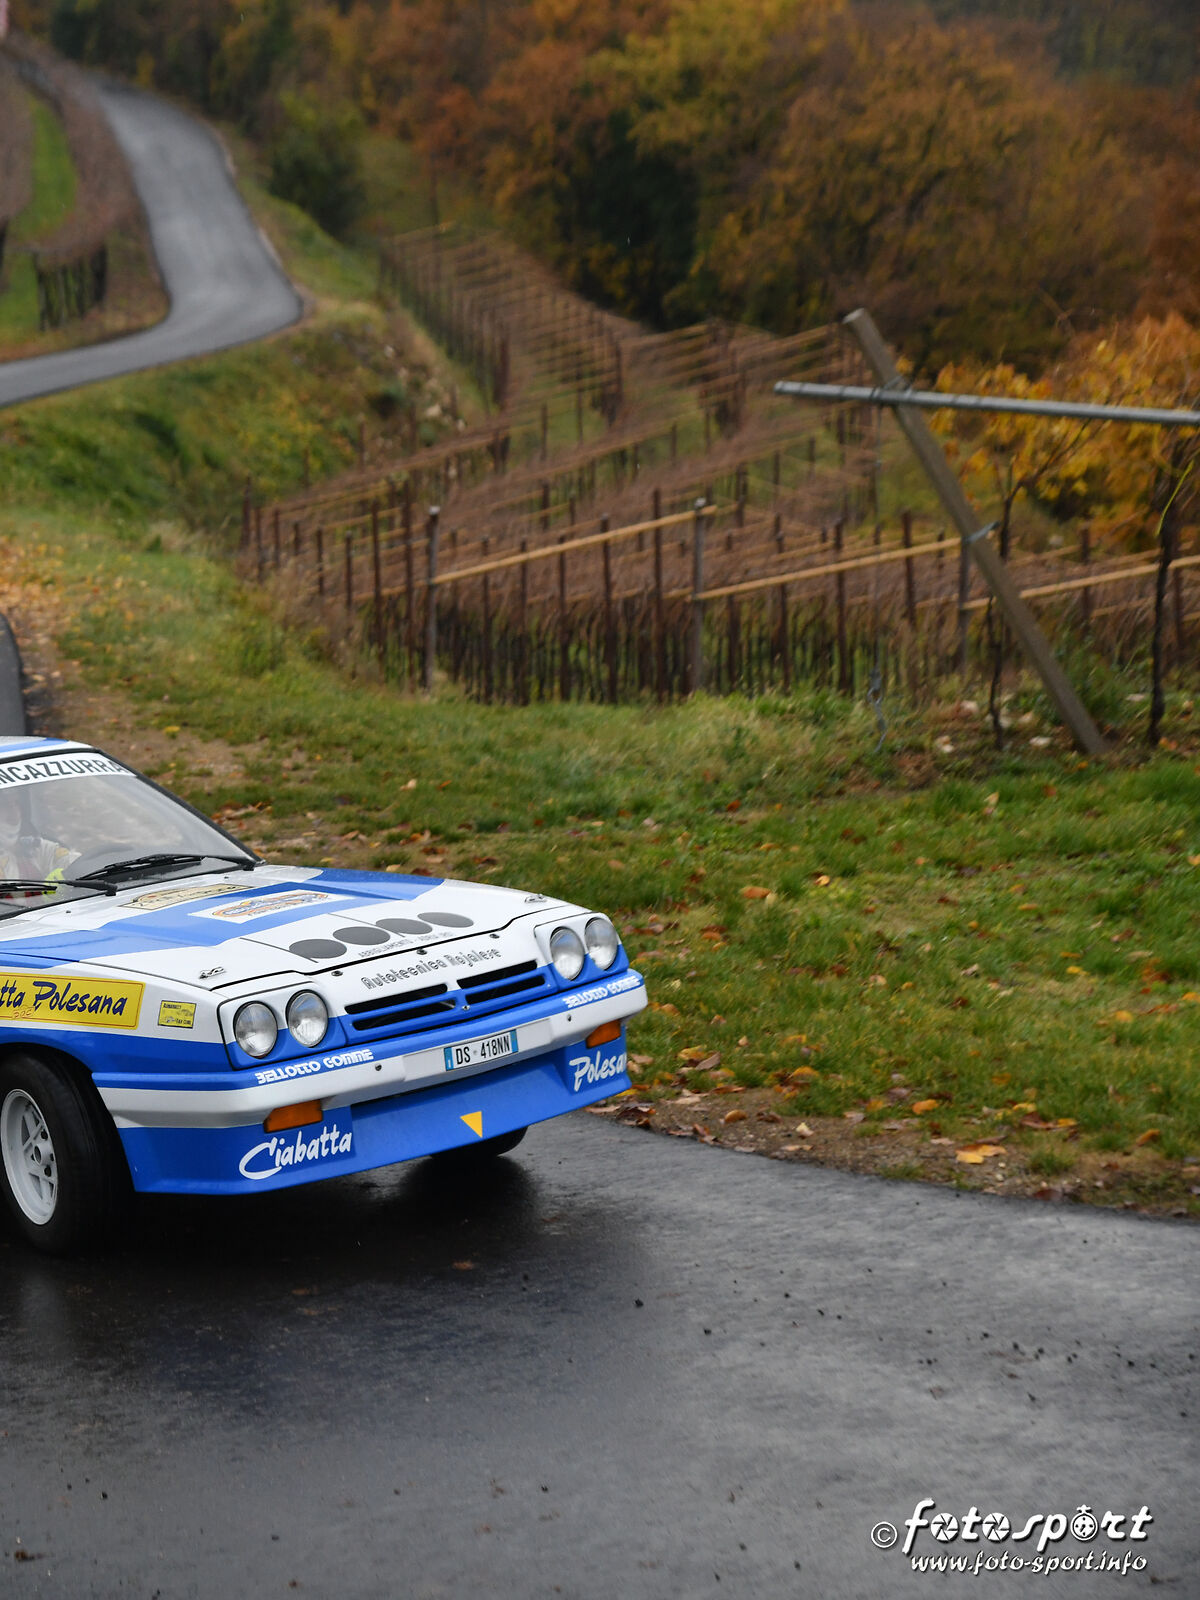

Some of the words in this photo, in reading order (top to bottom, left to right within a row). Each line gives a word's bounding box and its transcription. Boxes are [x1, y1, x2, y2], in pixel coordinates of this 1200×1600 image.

[360, 957, 447, 990] Autotecnica
[33, 980, 128, 1017] Polesana
[254, 1061, 321, 1085] BELLOTTO
[323, 1048, 375, 1069] GOMME
[455, 1047, 471, 1065] DS
[480, 1035, 511, 1059] 418NN
[238, 1123, 353, 1180] Ciabatta
